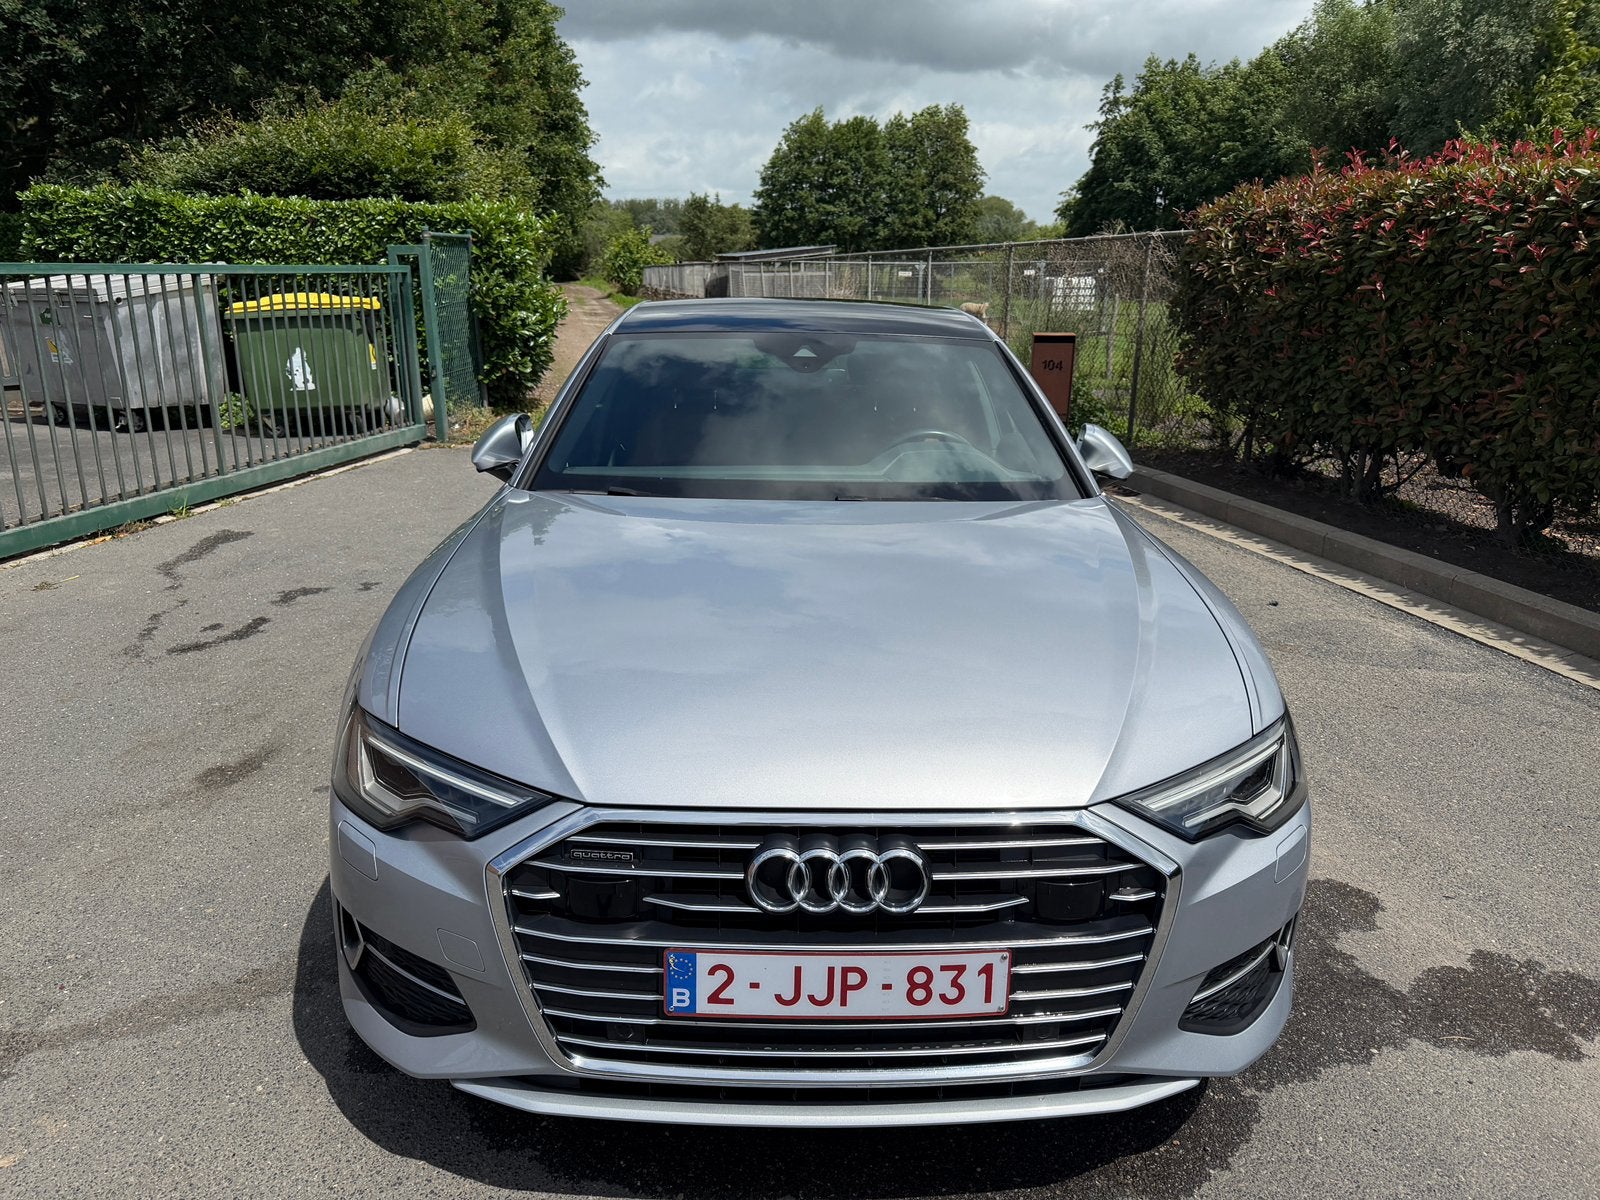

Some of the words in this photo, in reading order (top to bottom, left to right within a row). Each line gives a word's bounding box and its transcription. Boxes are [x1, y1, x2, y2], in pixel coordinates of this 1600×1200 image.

[1042, 360, 1064, 371] 104
[573, 851, 631, 860] quattro
[672, 988, 691, 1007] B
